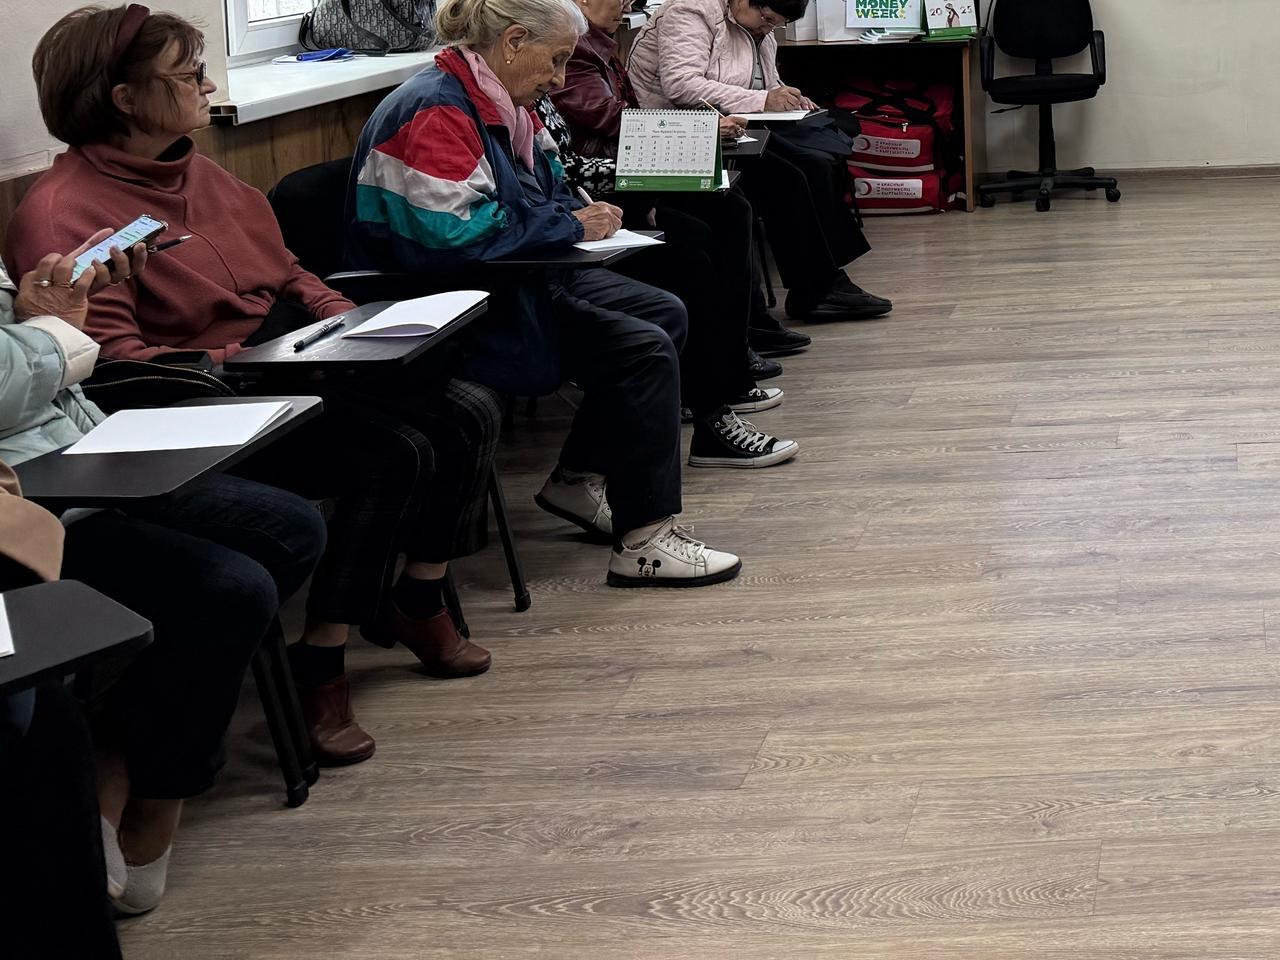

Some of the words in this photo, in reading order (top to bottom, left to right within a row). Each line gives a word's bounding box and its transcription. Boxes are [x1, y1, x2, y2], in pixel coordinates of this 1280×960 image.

[856, 0, 908, 9] MONEY
[856, 8, 899, 19] WEEK
[930, 7, 943, 17] 20
